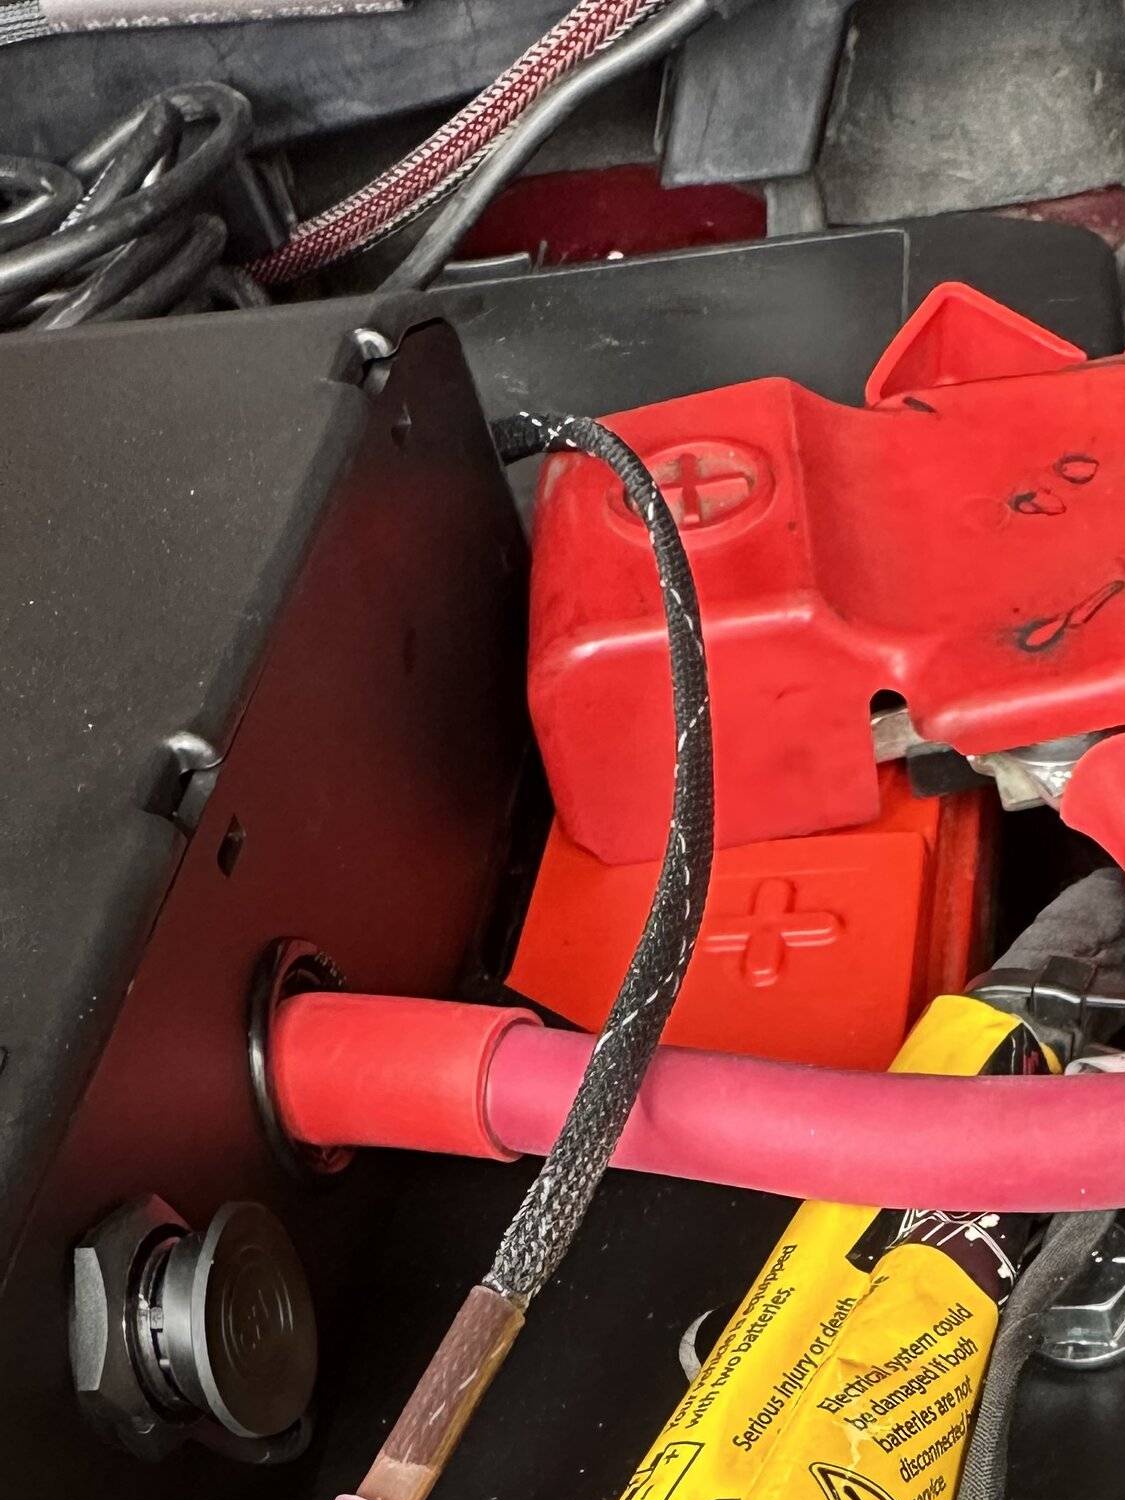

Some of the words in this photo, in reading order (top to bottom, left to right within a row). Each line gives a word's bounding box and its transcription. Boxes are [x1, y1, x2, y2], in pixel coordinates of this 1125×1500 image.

[741, 1243, 797, 1317] equipped
[819, 1296, 857, 1338] death
[809, 1340, 831, 1356] or
[817, 1362, 889, 1415] Electrical
[883, 1332, 937, 1371] system
[932, 1302, 974, 1337] could
[844, 1411, 877, 1431] be
[870, 1363, 940, 1417] damaged
[944, 1335, 978, 1366] both
[685, 1390, 719, 1429] with
[711, 1355, 742, 1387] two
[732, 1395, 784, 1451] Serious
[872, 1405, 937, 1454] batteries
[933, 1391, 956, 1417] are
[953, 1374, 973, 1404] not
[899, 1411, 966, 1484] disconnected
